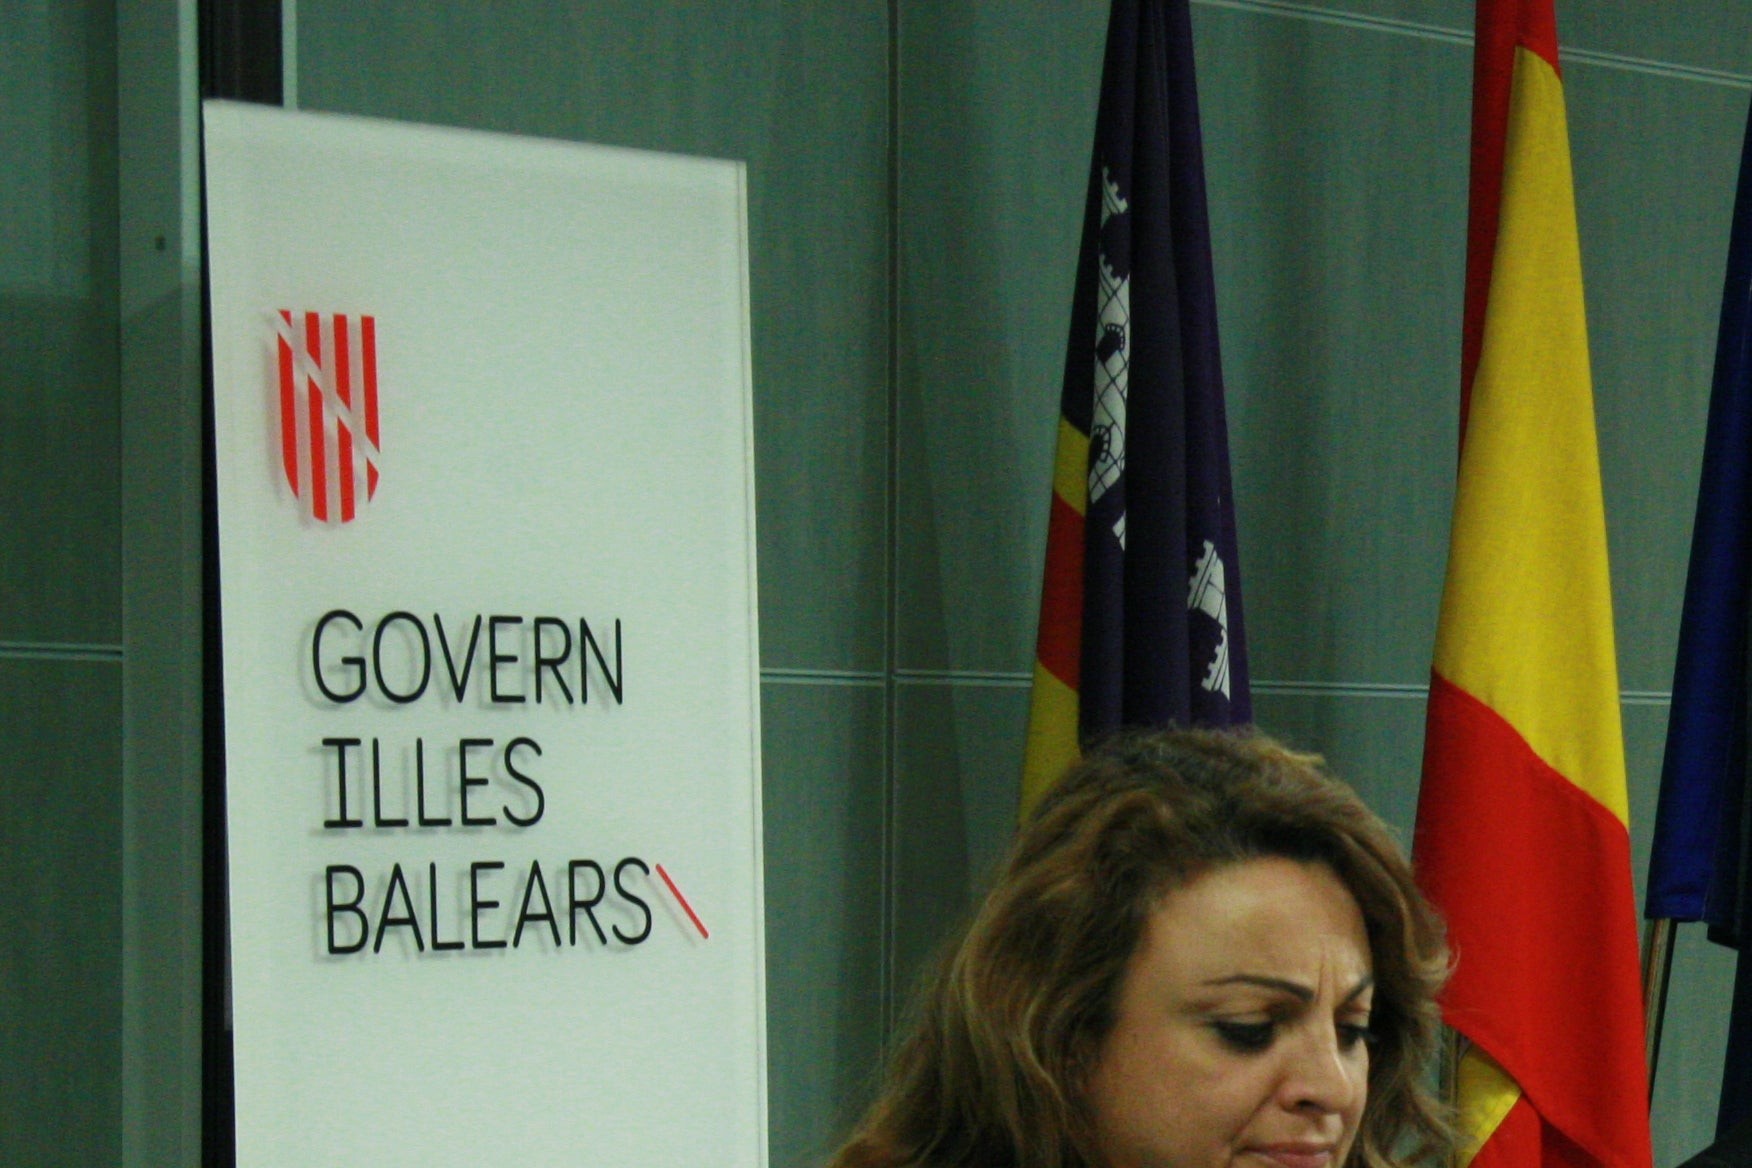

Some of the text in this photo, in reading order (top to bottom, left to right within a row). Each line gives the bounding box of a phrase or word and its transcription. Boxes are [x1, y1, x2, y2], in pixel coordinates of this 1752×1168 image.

[312, 609, 624, 705] GOVERN
[321, 736, 546, 829] ILLES
[325, 856, 653, 955] BALEARS
